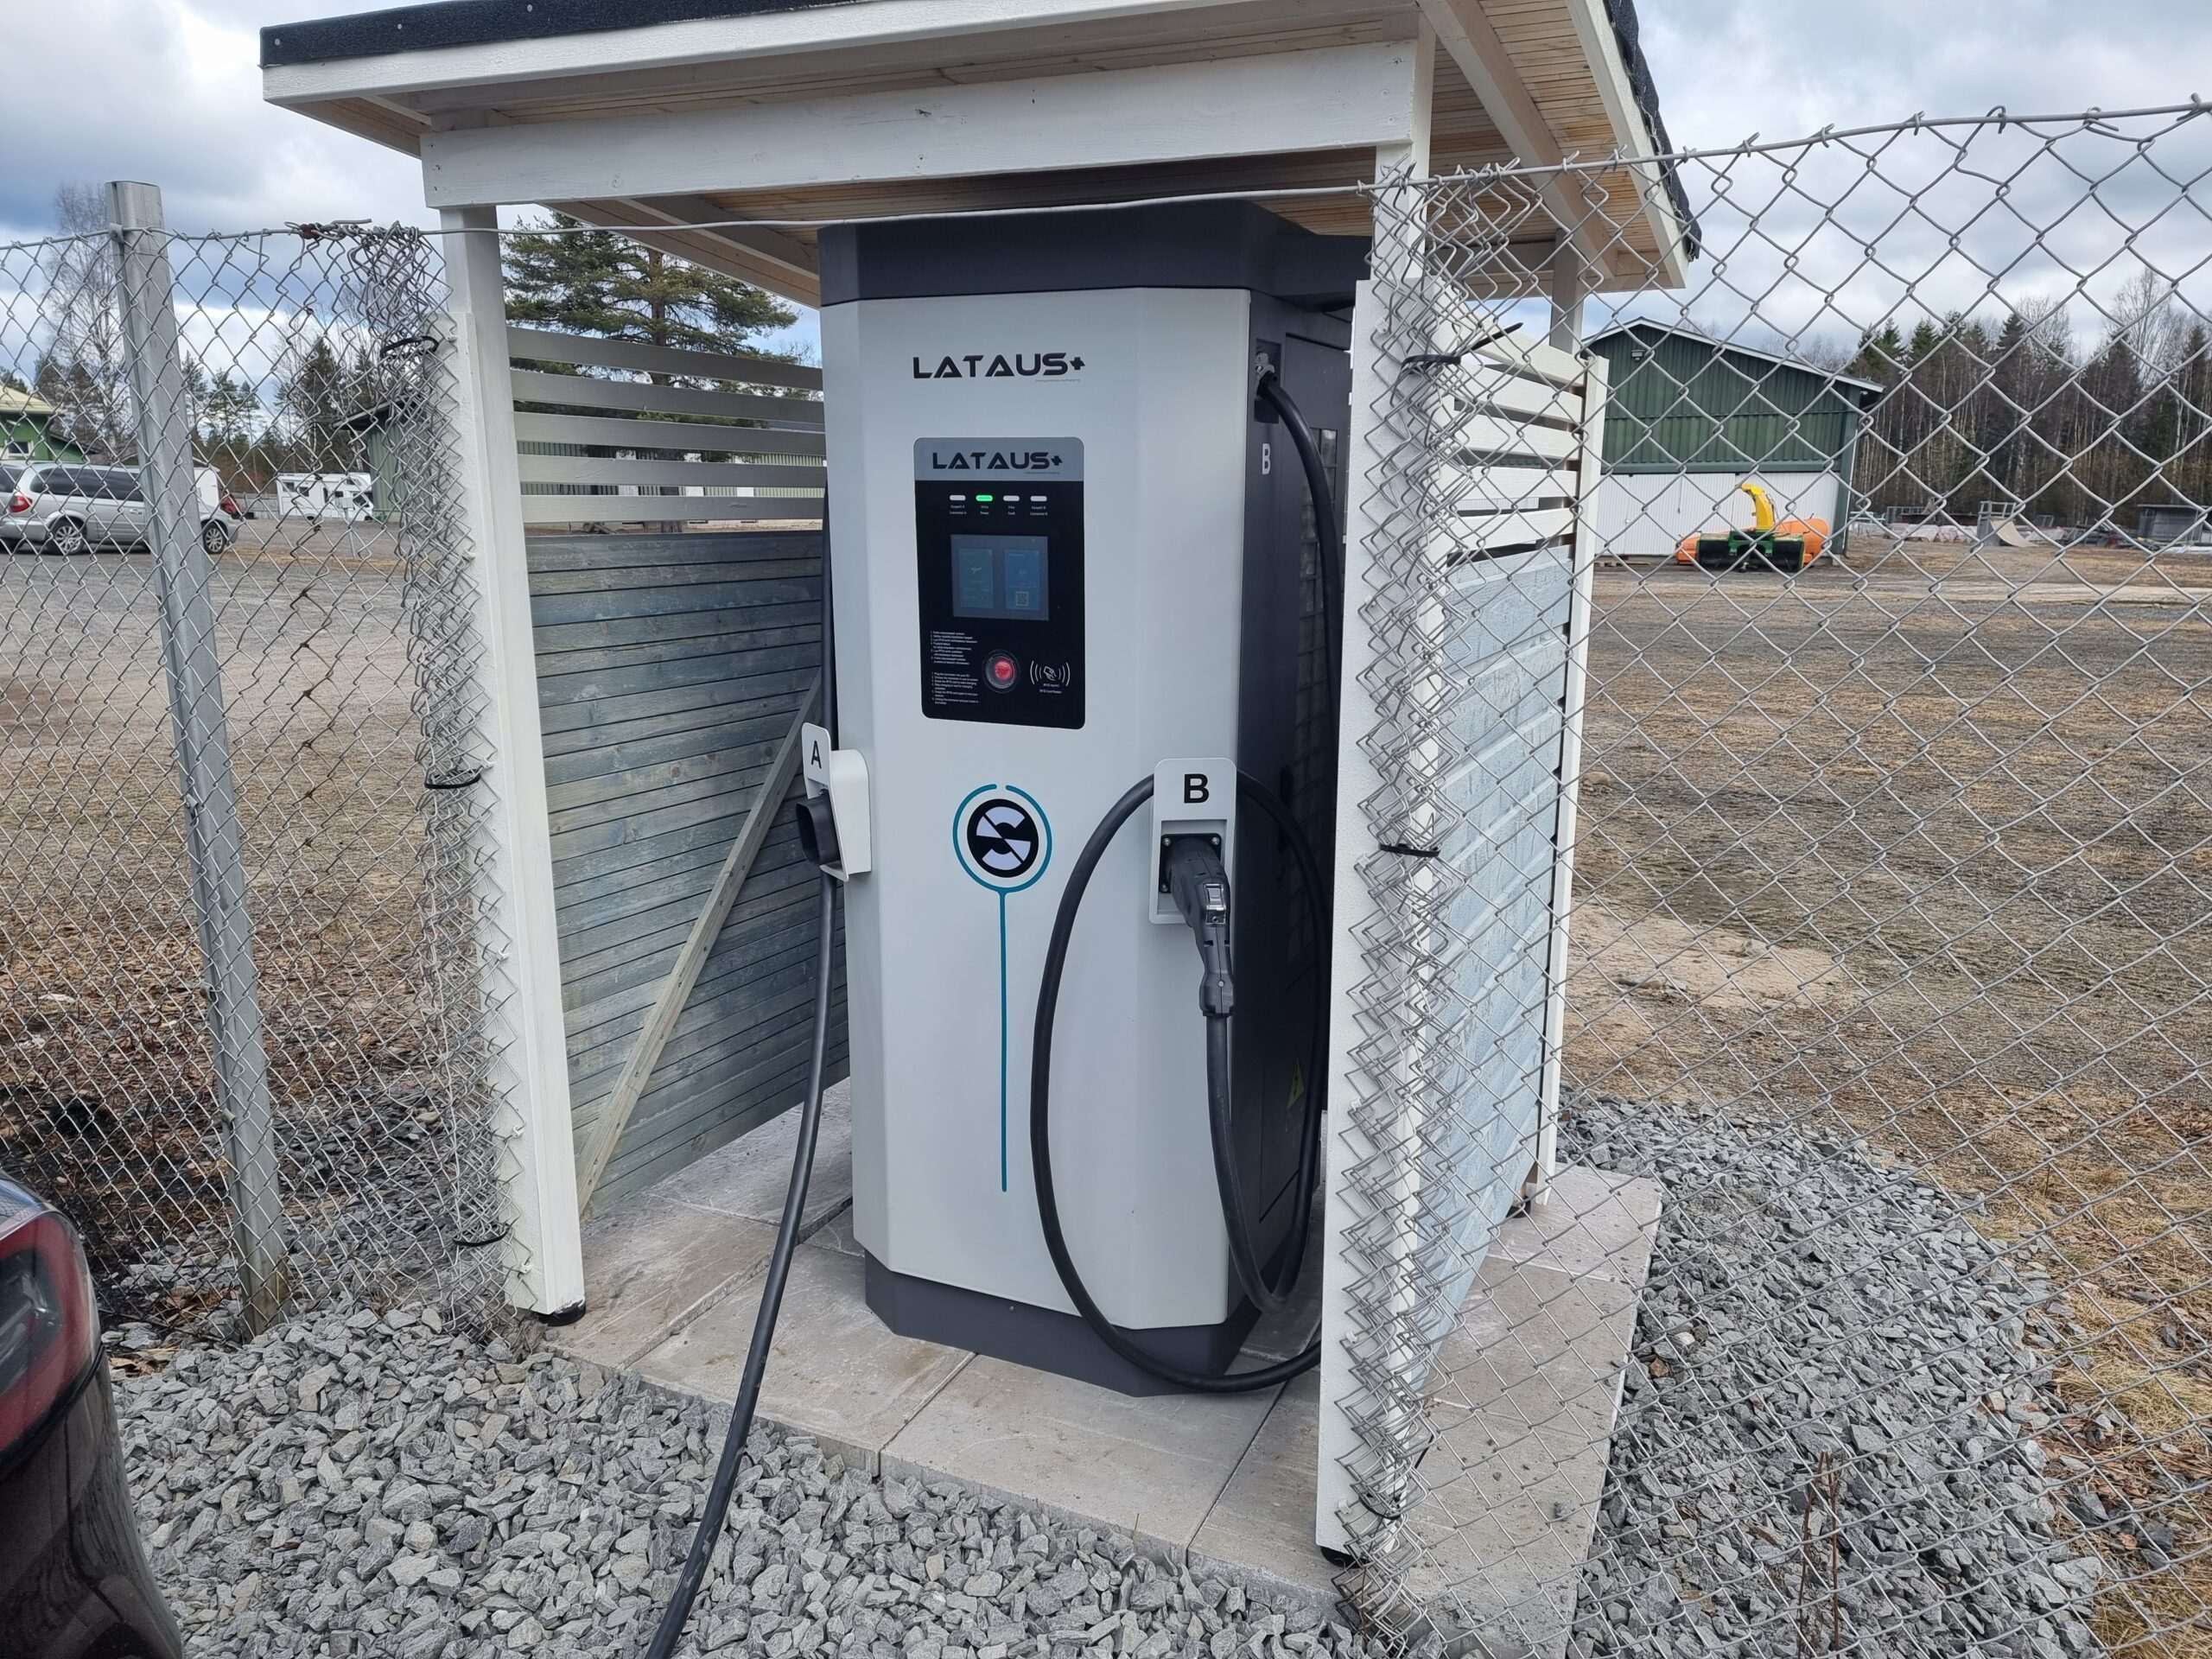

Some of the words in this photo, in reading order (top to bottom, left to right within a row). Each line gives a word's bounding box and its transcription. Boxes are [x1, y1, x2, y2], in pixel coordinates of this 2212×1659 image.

[912, 353, 1085, 378] LATAUS+
[932, 452, 1063, 469] LATAUS+
[1262, 442, 1271, 475] B
[810, 740, 822, 769] A
[1184, 773, 1210, 804] B
